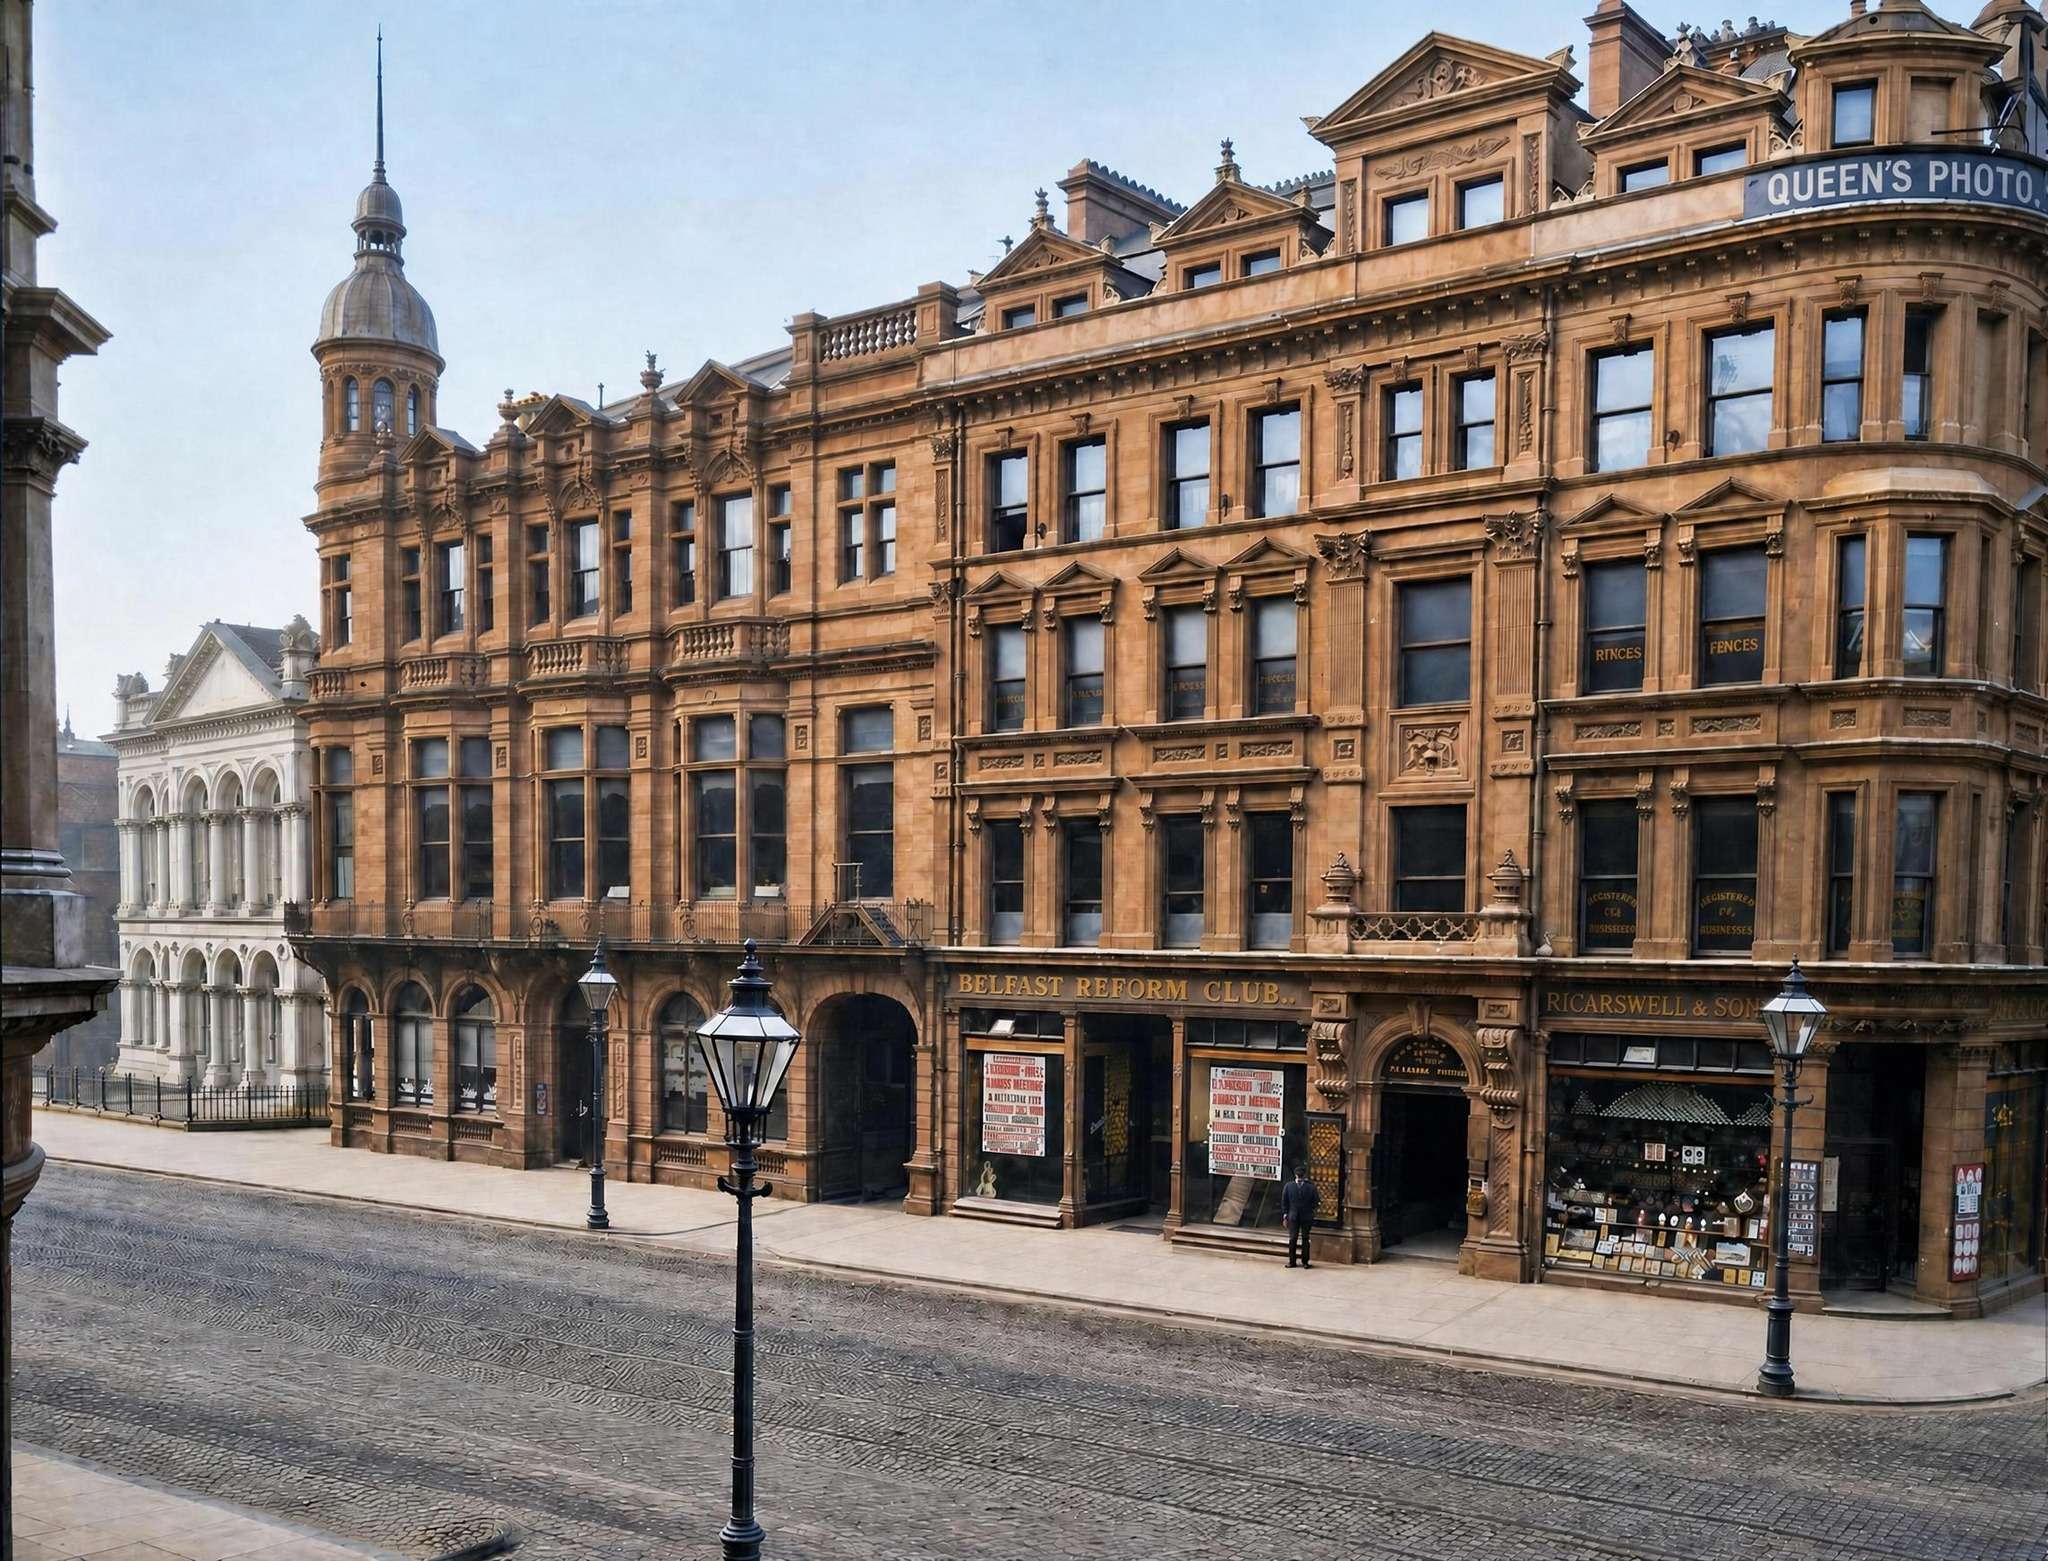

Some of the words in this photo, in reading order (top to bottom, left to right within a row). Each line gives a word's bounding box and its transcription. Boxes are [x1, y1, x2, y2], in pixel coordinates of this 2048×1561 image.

[1767, 160, 1912, 205] QUEEN'S
[958, 974, 1064, 997] BELFAST
[1076, 977, 1189, 1001] REFORM
[1692, 1000, 1708, 1017] &
